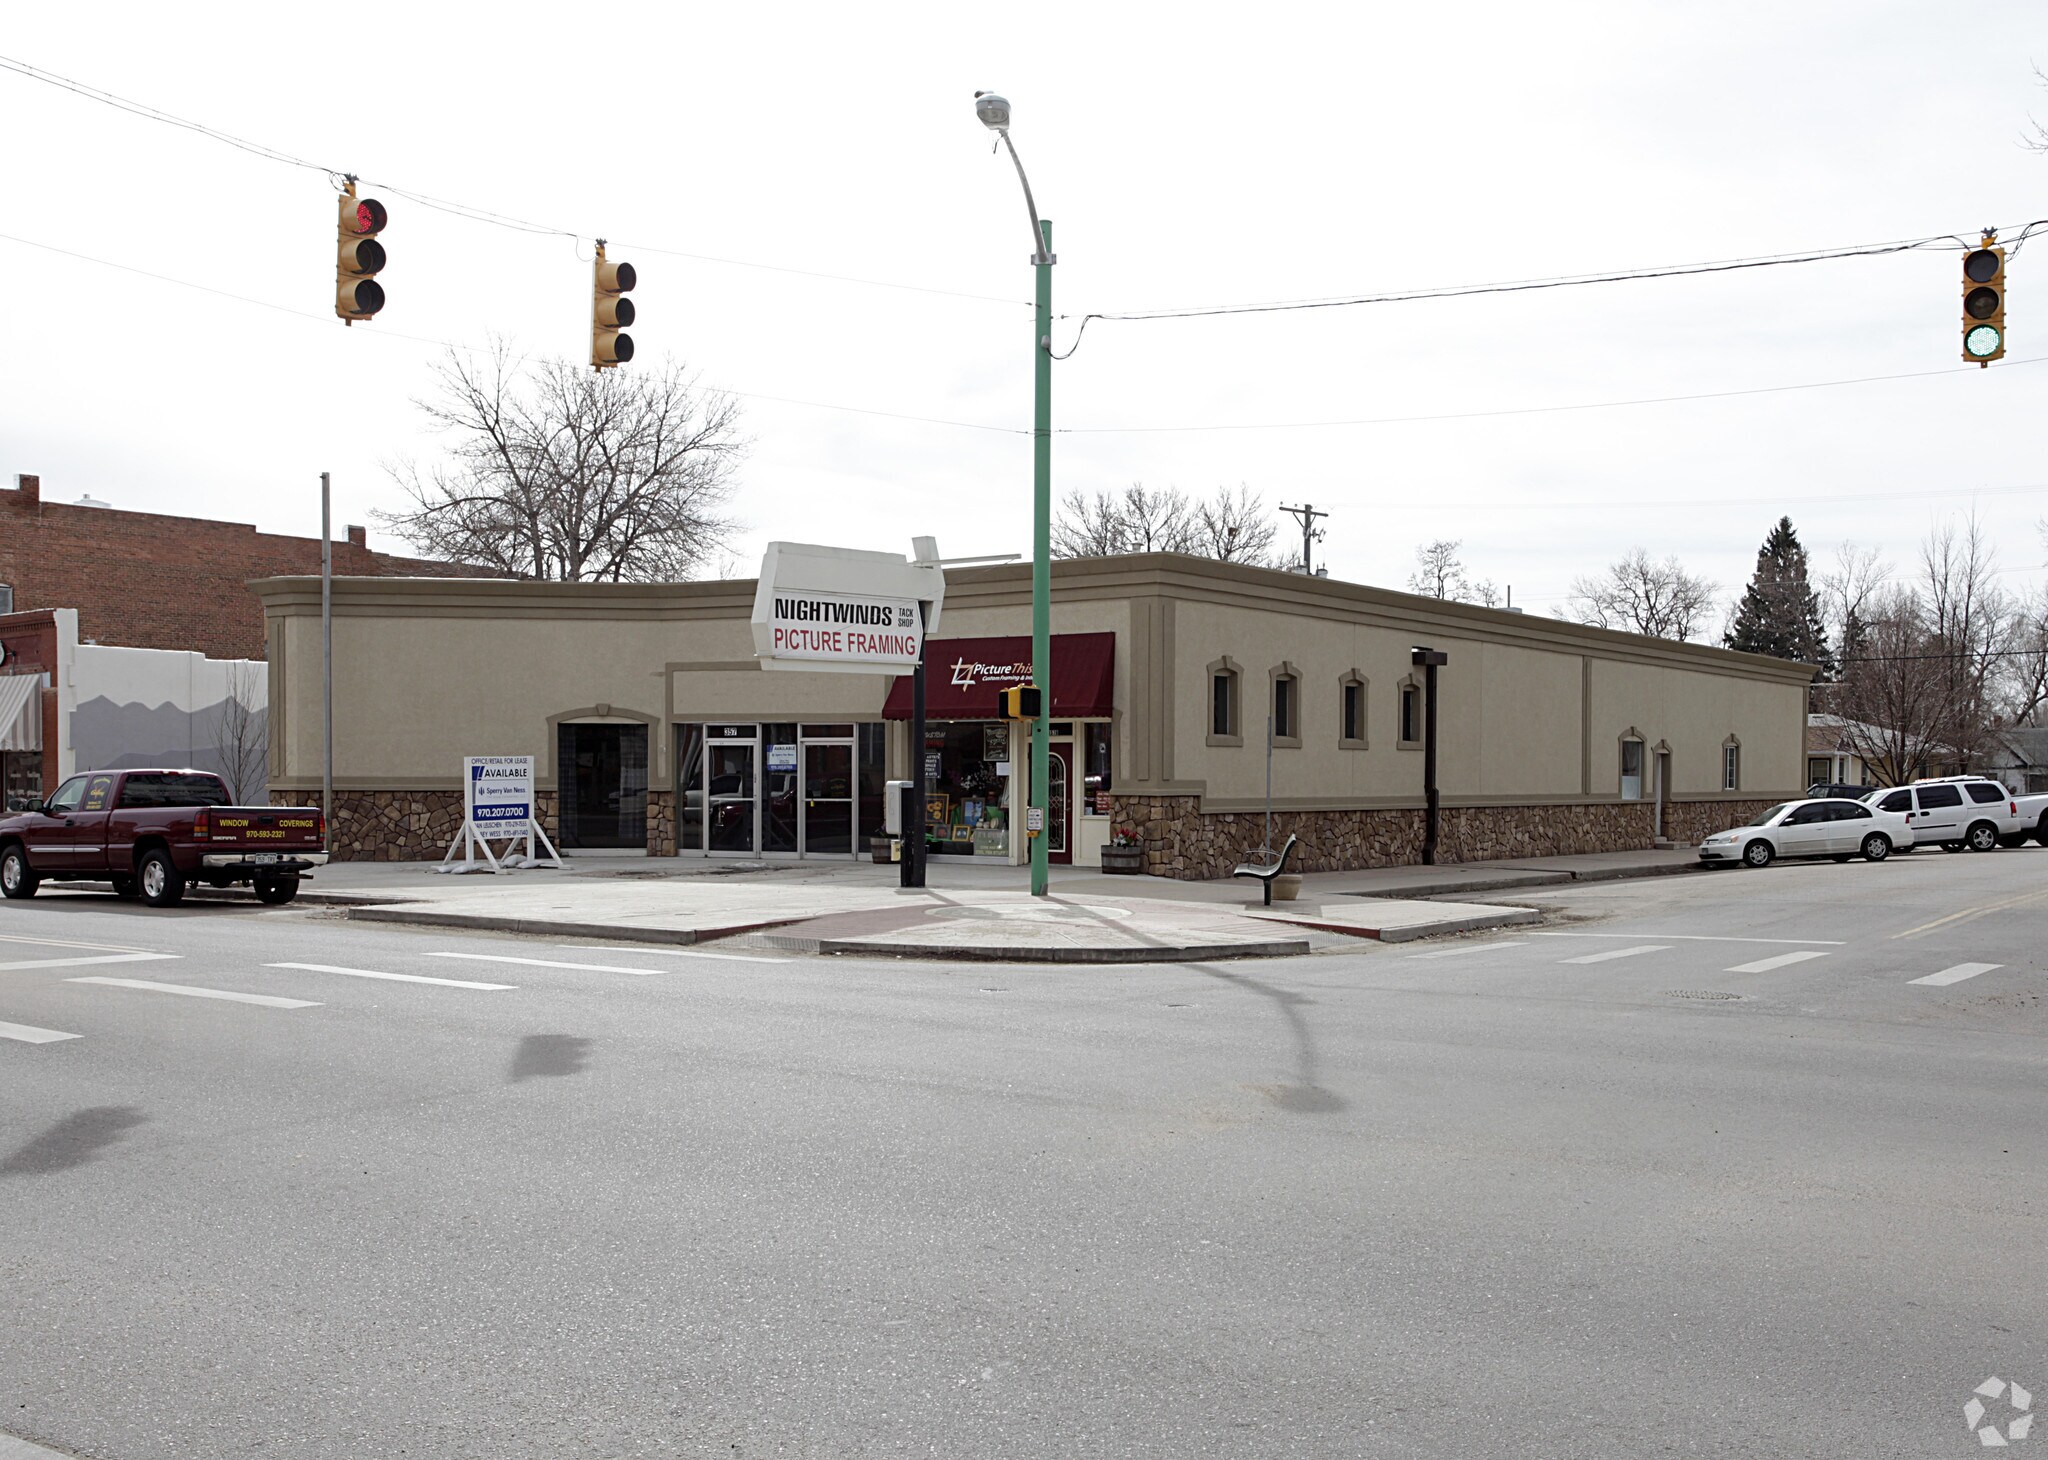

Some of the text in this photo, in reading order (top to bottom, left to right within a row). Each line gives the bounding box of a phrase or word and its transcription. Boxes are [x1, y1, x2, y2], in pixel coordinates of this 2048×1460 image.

[775, 598, 892, 627] NIGHTWINDS
[899, 607, 914, 618] TACK
[898, 618, 914, 628] SHOP
[774, 628, 916, 656] PICTURE FRAMING
[724, 727, 737, 736] 357
[484, 768, 527, 778] AVAILABLE
[486, 787, 502, 795] Sperry
[477, 807, 524, 818] 970.207.0700
[219, 819, 249, 827] WINDOW
[246, 830, 285, 838] 970-593-2321
